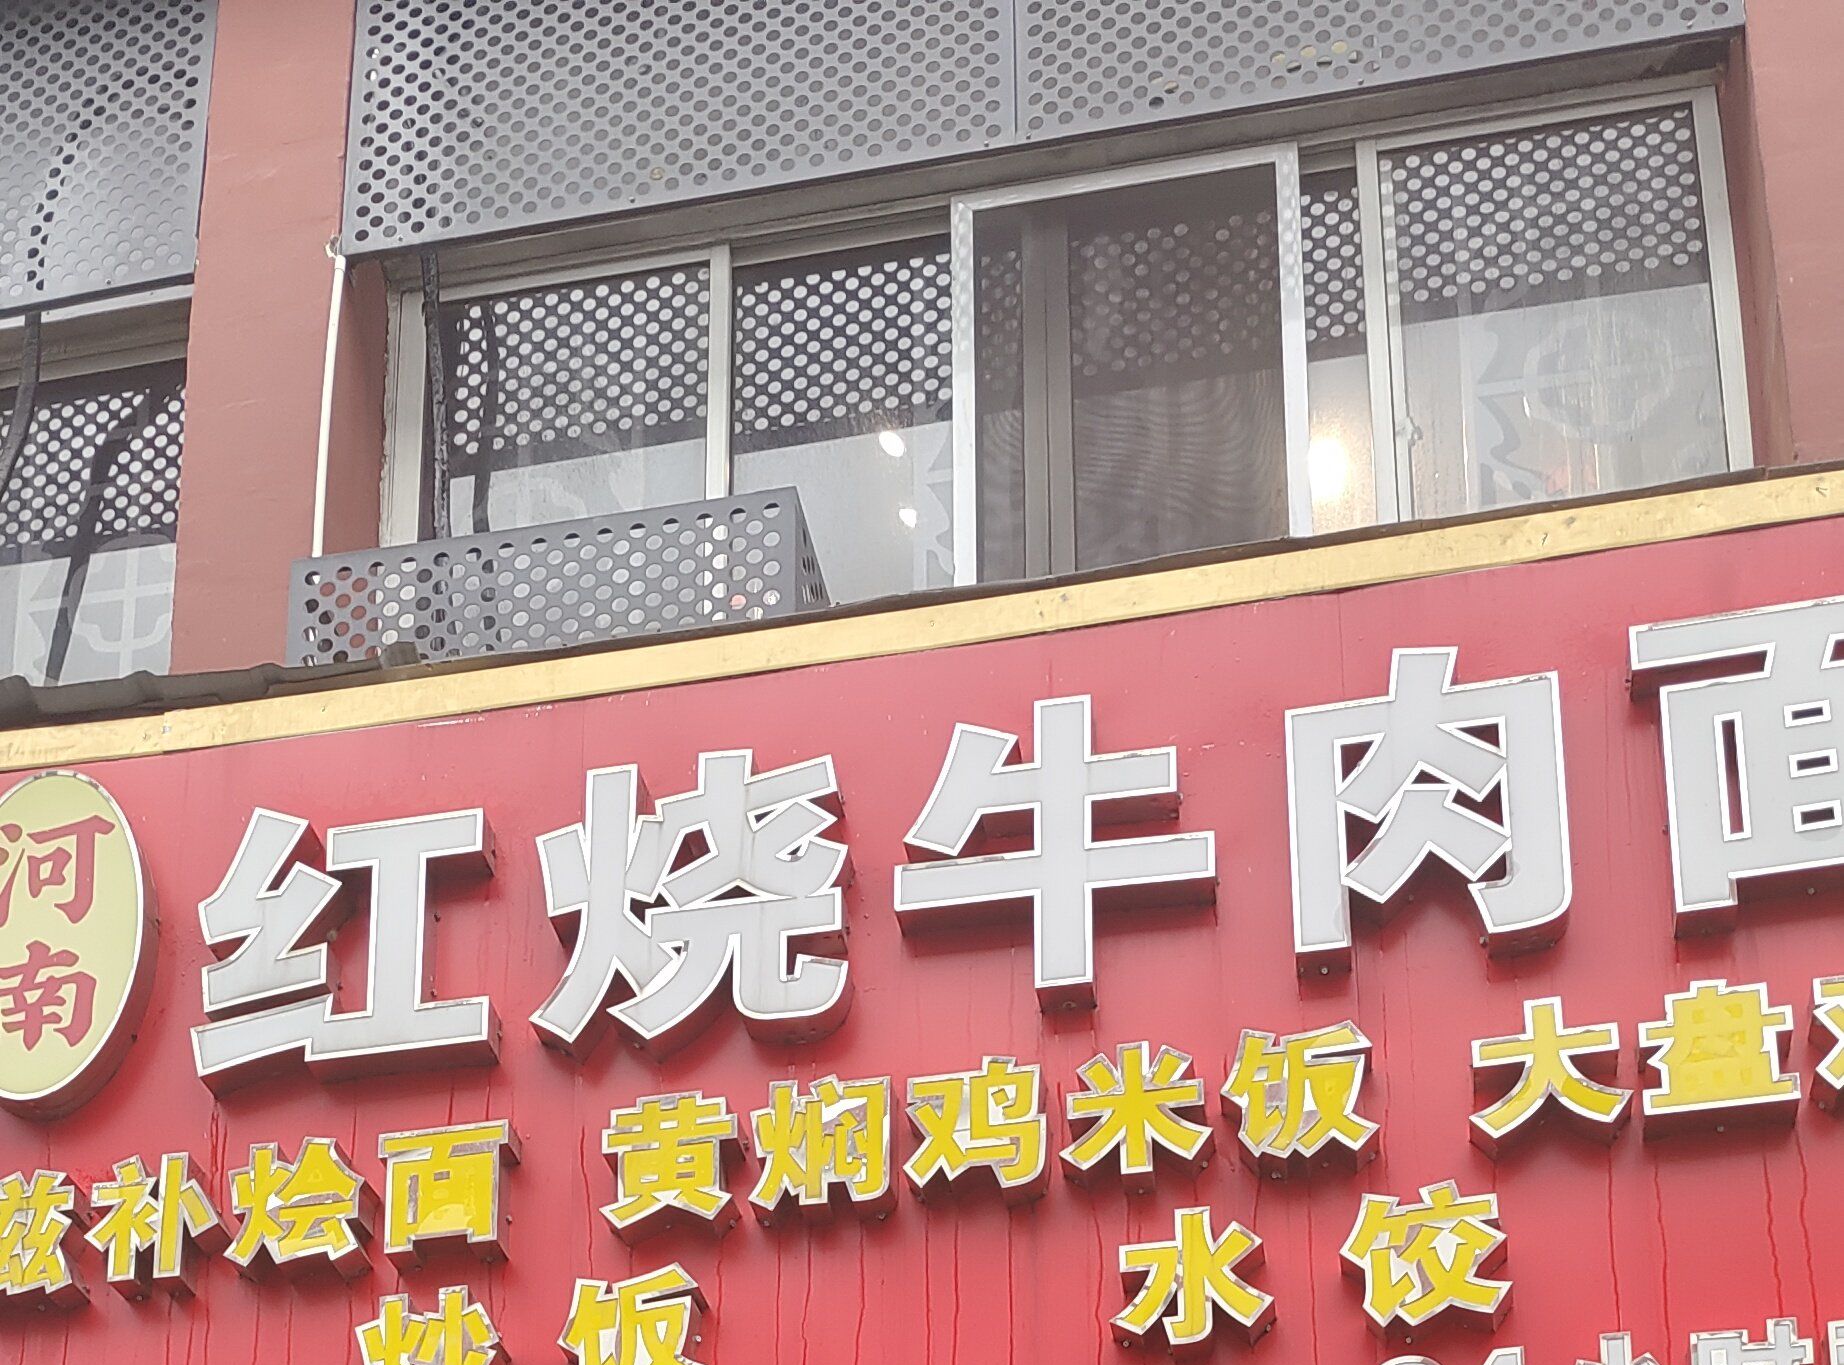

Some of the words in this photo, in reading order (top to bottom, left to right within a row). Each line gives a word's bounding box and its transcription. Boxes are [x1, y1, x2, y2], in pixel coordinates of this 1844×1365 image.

[0, 812, 118, 1052] 河南
[192, 597, 1844, 1077] 红烧牛肉面
[600, 1021, 1379, 1232] 黄焖鸡米饭
[1111, 1180, 1512, 1347] 水饺
